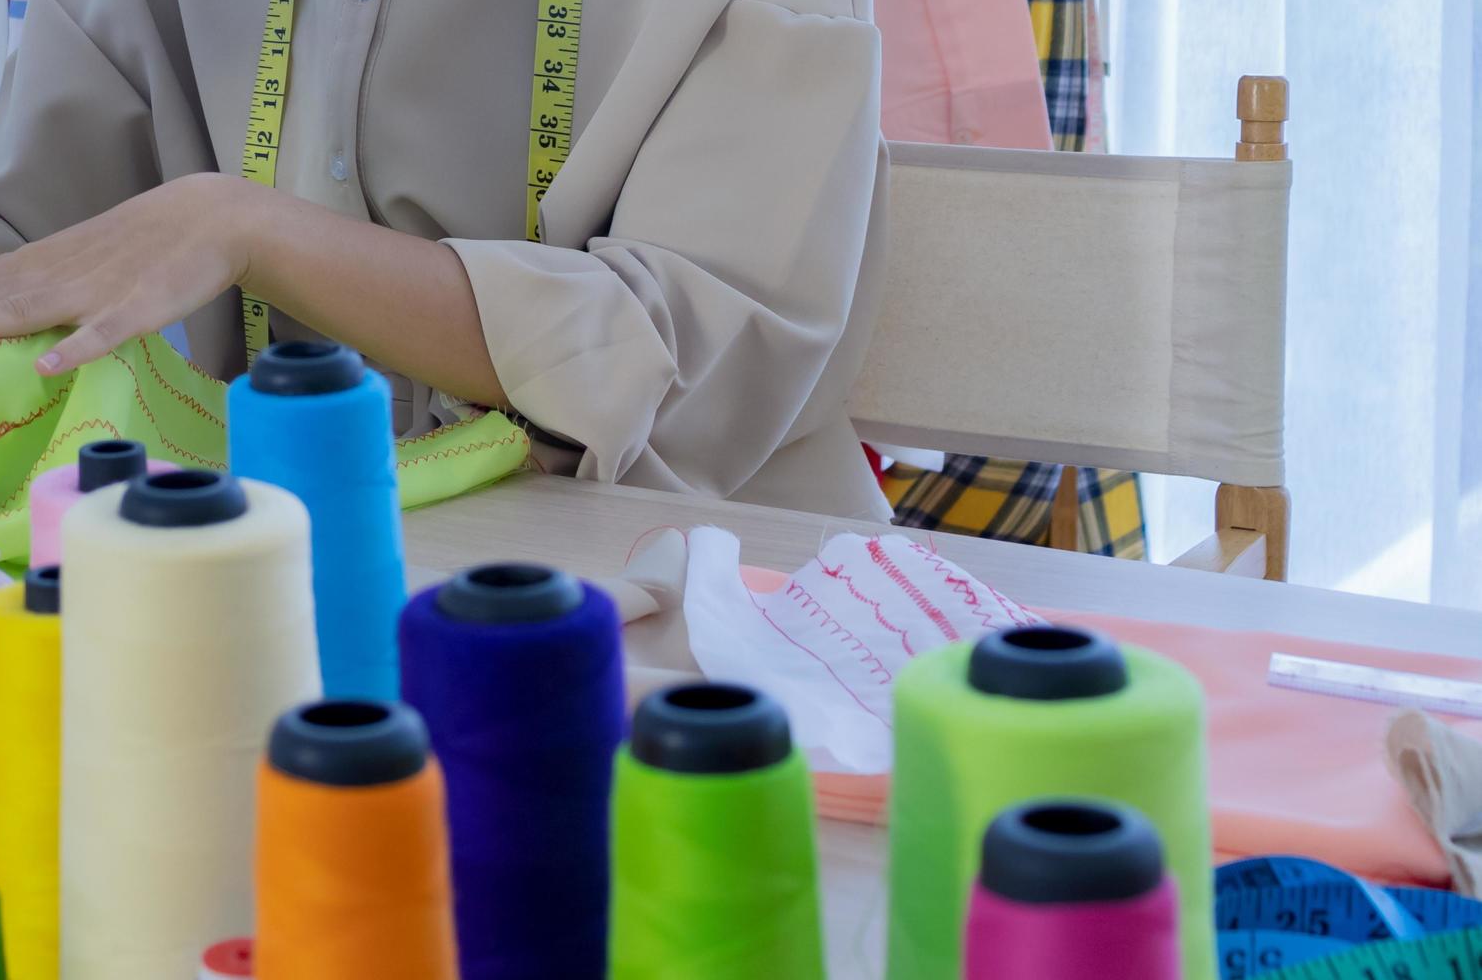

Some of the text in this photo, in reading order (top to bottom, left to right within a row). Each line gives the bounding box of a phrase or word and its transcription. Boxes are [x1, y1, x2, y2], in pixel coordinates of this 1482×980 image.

[547, 5, 568, 38] 33
[271, 27, 287, 56] 14
[542, 59, 563, 93] 34
[263, 78, 279, 109] 13
[254, 131, 273, 161] 12
[538, 114, 559, 148] 35
[252, 303, 264, 317] 9
[1275, 907, 1330, 936] 25
